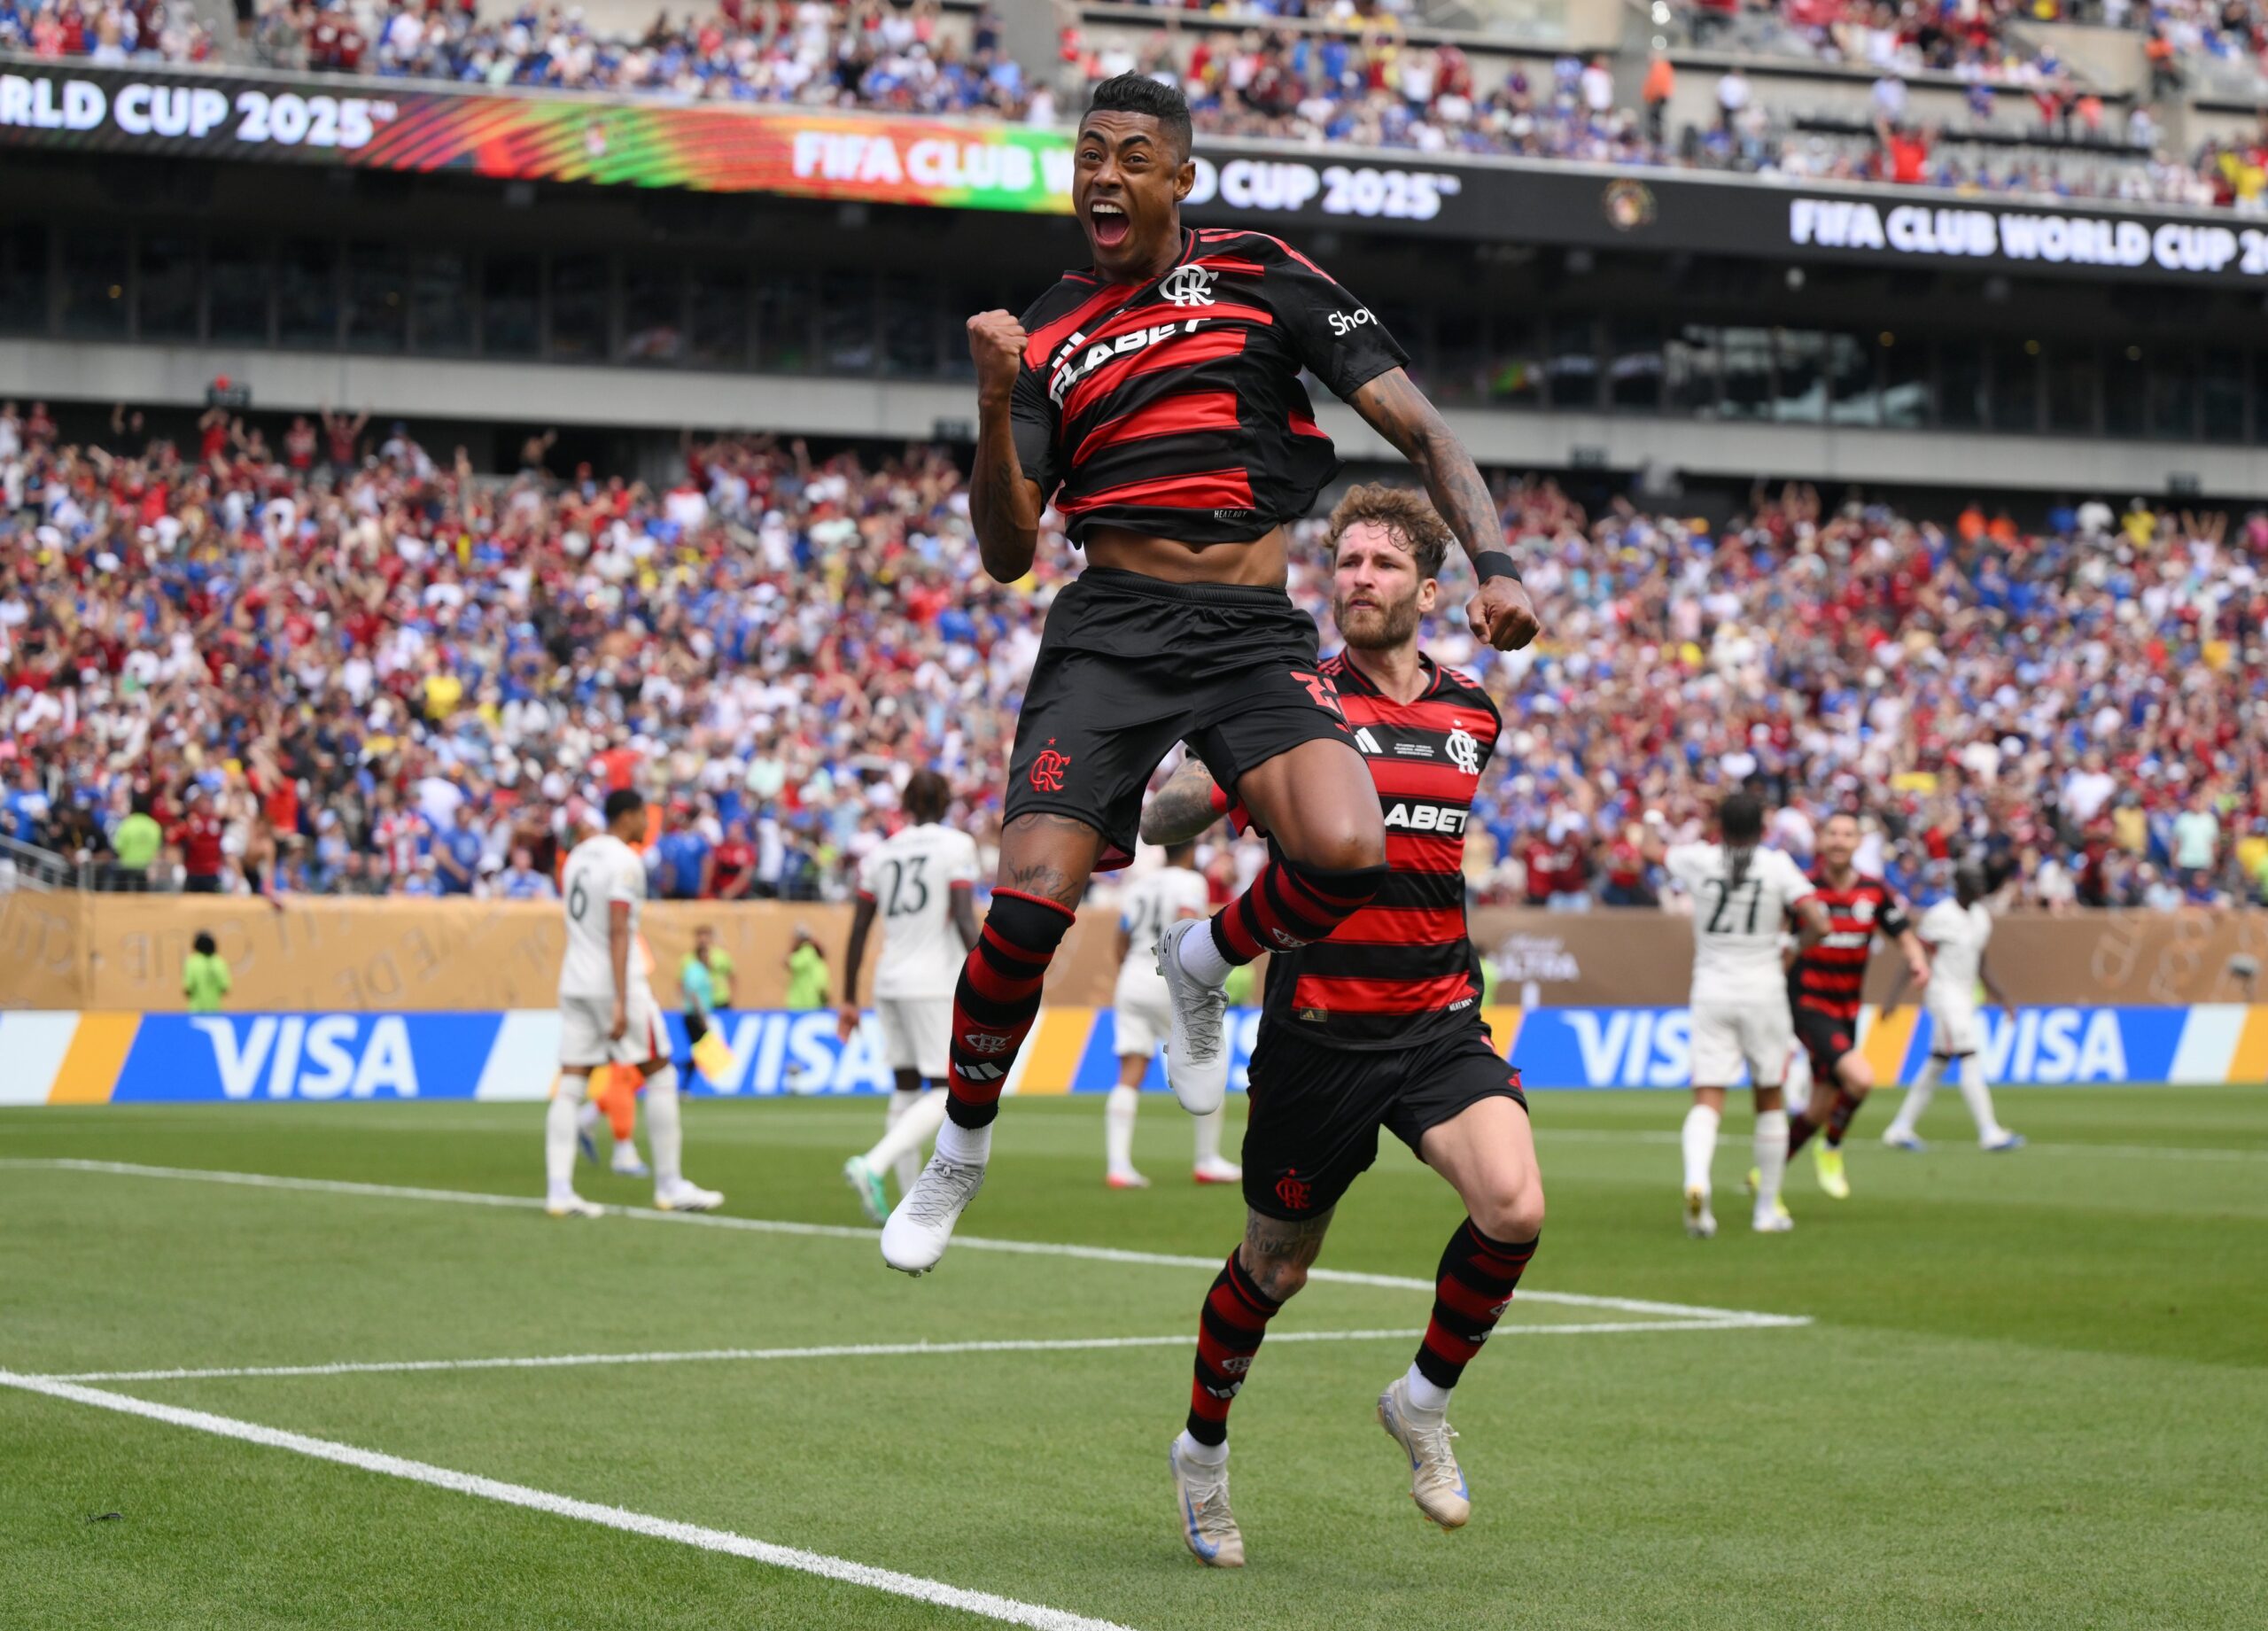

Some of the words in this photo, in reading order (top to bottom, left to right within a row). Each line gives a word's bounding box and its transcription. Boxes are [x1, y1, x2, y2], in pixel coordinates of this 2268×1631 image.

[113, 83, 229, 137] CUP
[793, 131, 902, 184] FIFA
[906, 139, 1034, 193] CLUB
[1220, 159, 1320, 211] CUP
[1790, 199, 1884, 250] FIFA
[1886, 206, 1998, 257] CLUB
[1999, 214, 2151, 267] WORLD
[2153, 224, 2238, 272] CUP
[569, 866, 590, 922] 6
[883, 856, 929, 917] 23
[1703, 878, 1763, 935] 27
[190, 1014, 419, 1099] VISA
[706, 1013, 895, 1095] VISA
[1561, 1008, 1691, 1089] VIS
[1976, 1006, 2128, 1084] VISA
